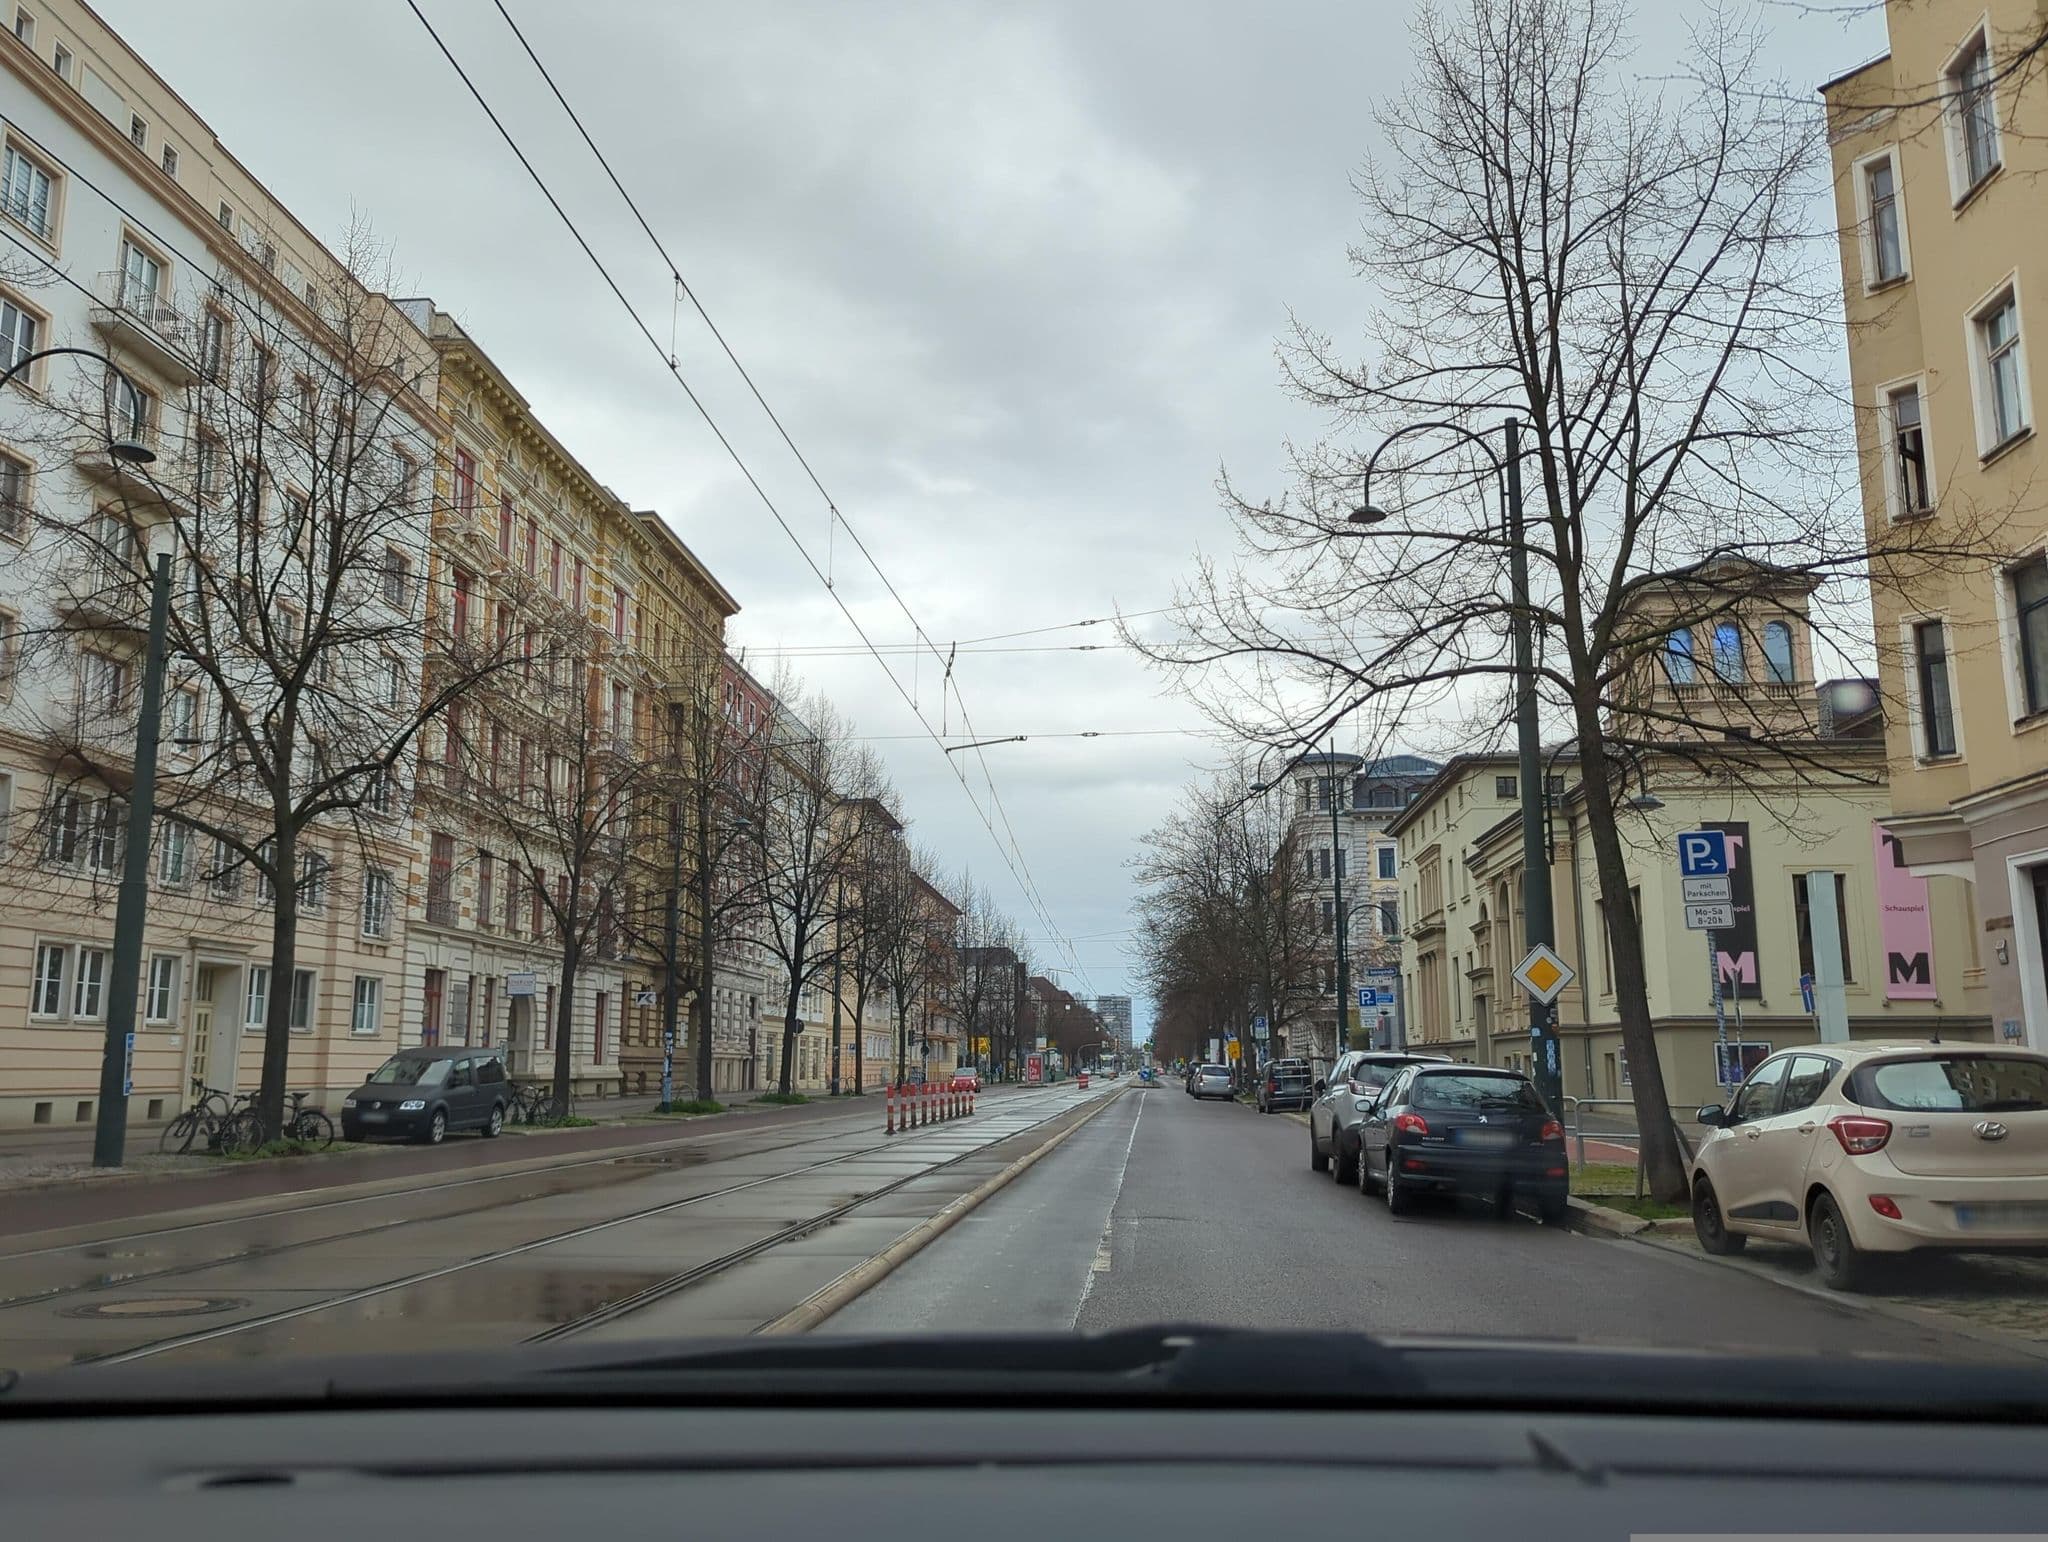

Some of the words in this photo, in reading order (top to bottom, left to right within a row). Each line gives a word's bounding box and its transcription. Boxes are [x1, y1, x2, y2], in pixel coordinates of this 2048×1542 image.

[1686, 838, 1711, 871] P
[1700, 882, 1712, 890] mit
[1687, 889, 1727, 898] Parkschein
[1695, 907, 1723, 917] Mo-Sa
[1732, 904, 1750, 914] spiel
[1884, 904, 1925, 913] Schauspiel
[1717, 951, 1757, 983] M
[1888, 952, 1930, 984] M
[1361, 991, 1371, 1005] P
